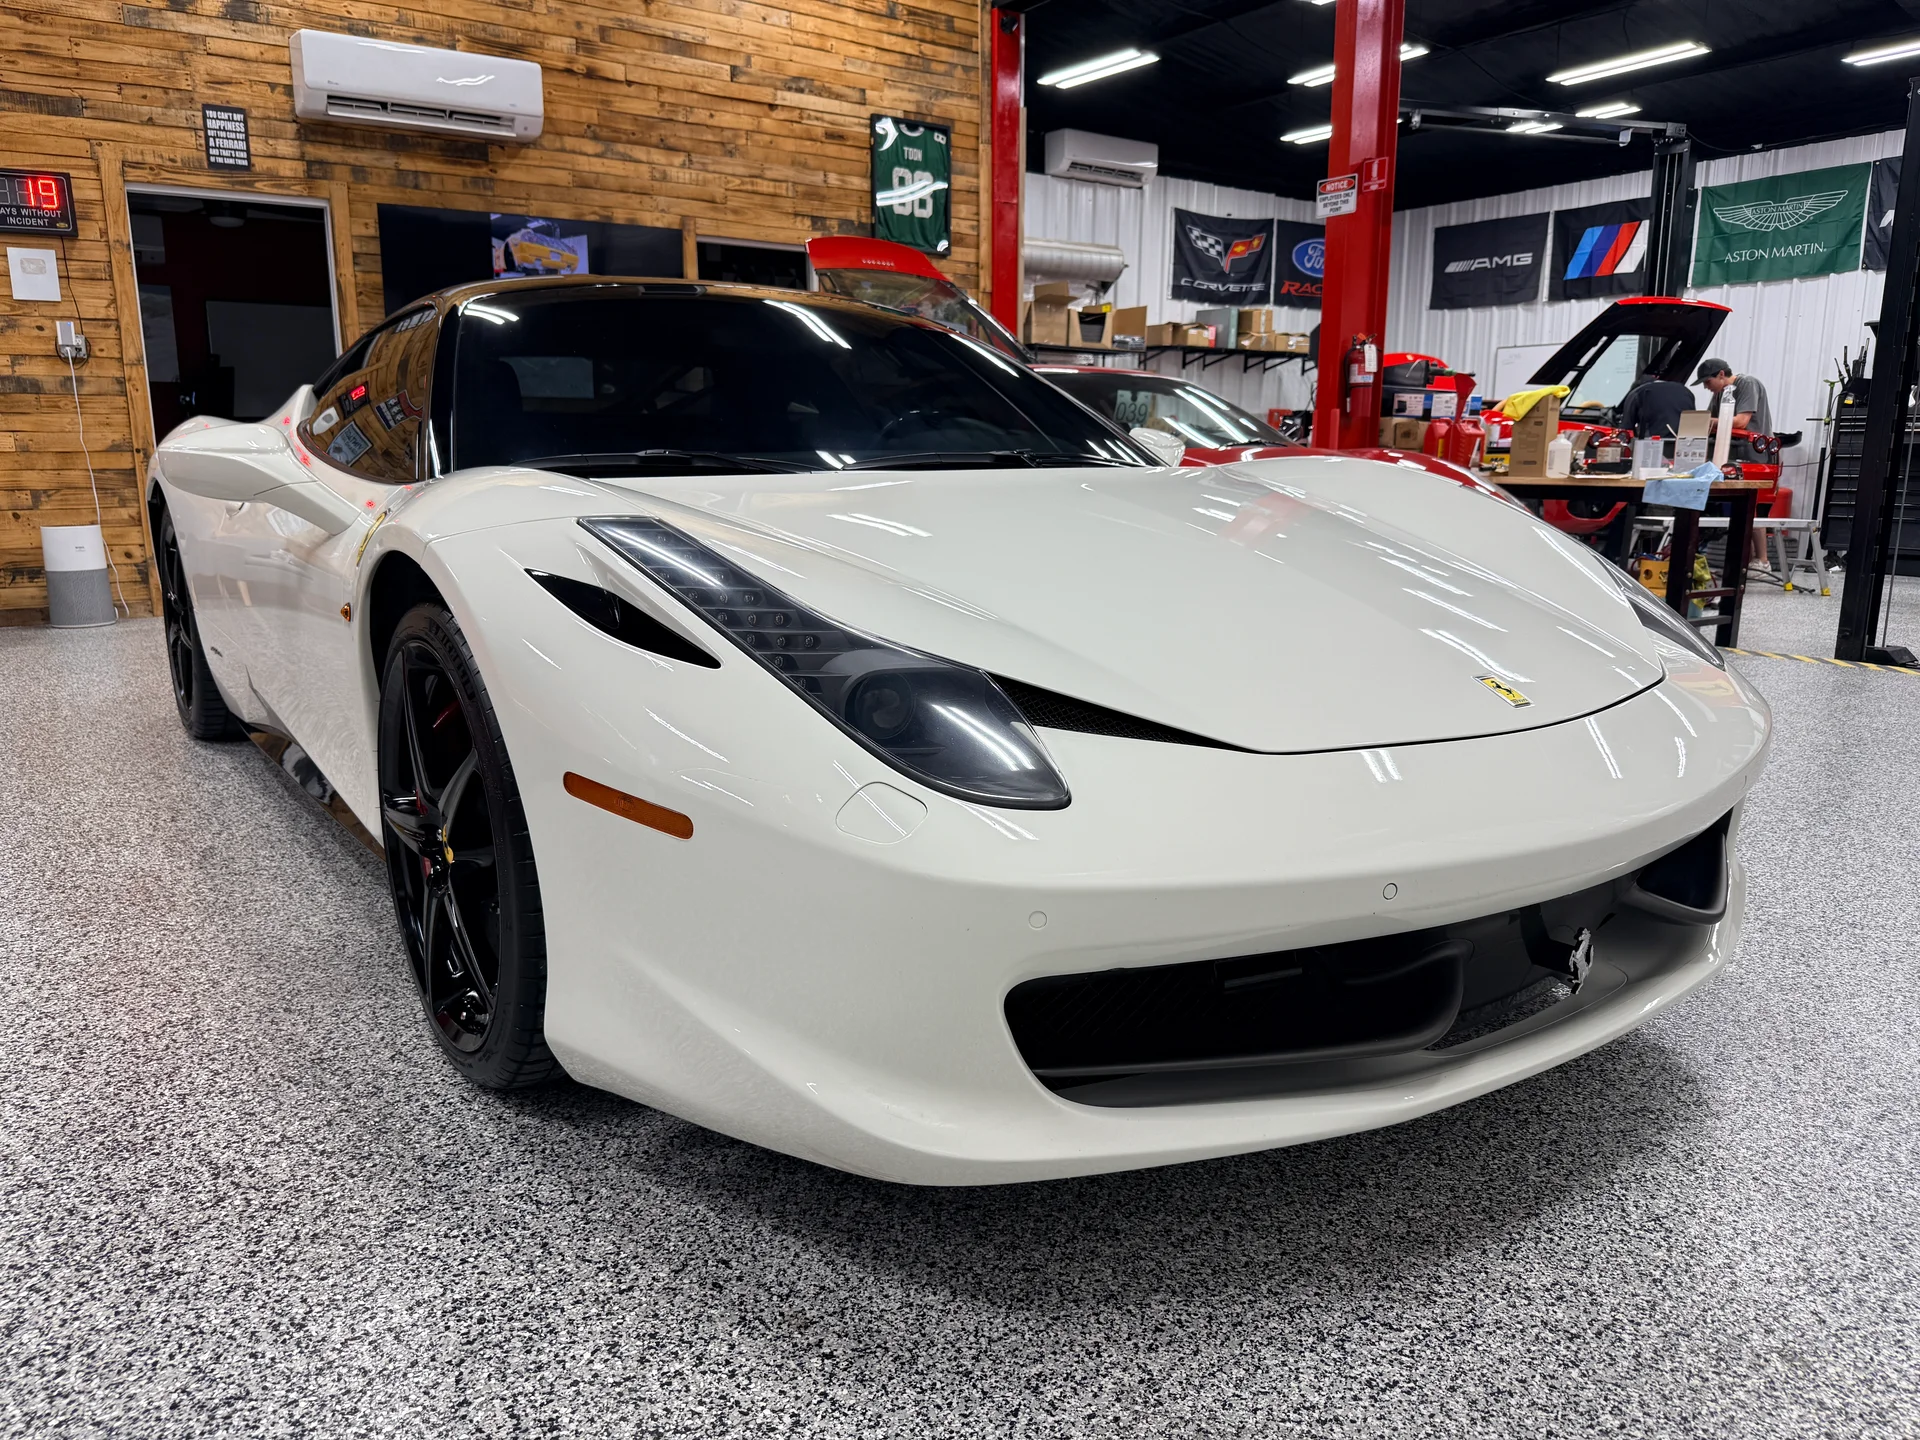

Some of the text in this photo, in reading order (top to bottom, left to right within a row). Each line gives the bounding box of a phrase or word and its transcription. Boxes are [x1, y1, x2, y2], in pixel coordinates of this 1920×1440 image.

[206, 118, 245, 132] HAPPINESS
[209, 137, 247, 150] A FERRARI
[903, 146, 923, 162] TOON
[28, 178, 58, 209] 19
[1326, 180, 1349, 192] NOTICE
[1319, 191, 1354, 203] EMPLOYEES ONLY
[1323, 198, 1349, 209] BEYOND THIS
[0, 207, 62, 219] AYS WITHOUT
[1752, 202, 1804, 216] ASTON MARTIN
[7, 216, 49, 227] INCIDENT
[1304, 243, 1324, 269] Fo
[1724, 241, 1825, 263] ASTON MARTIN
[1470, 252, 1533, 271] AMG
[1180, 276, 1266, 293] CORVETTE
[1280, 280, 1324, 297] RAC
[1116, 402, 1148, 424] 039
